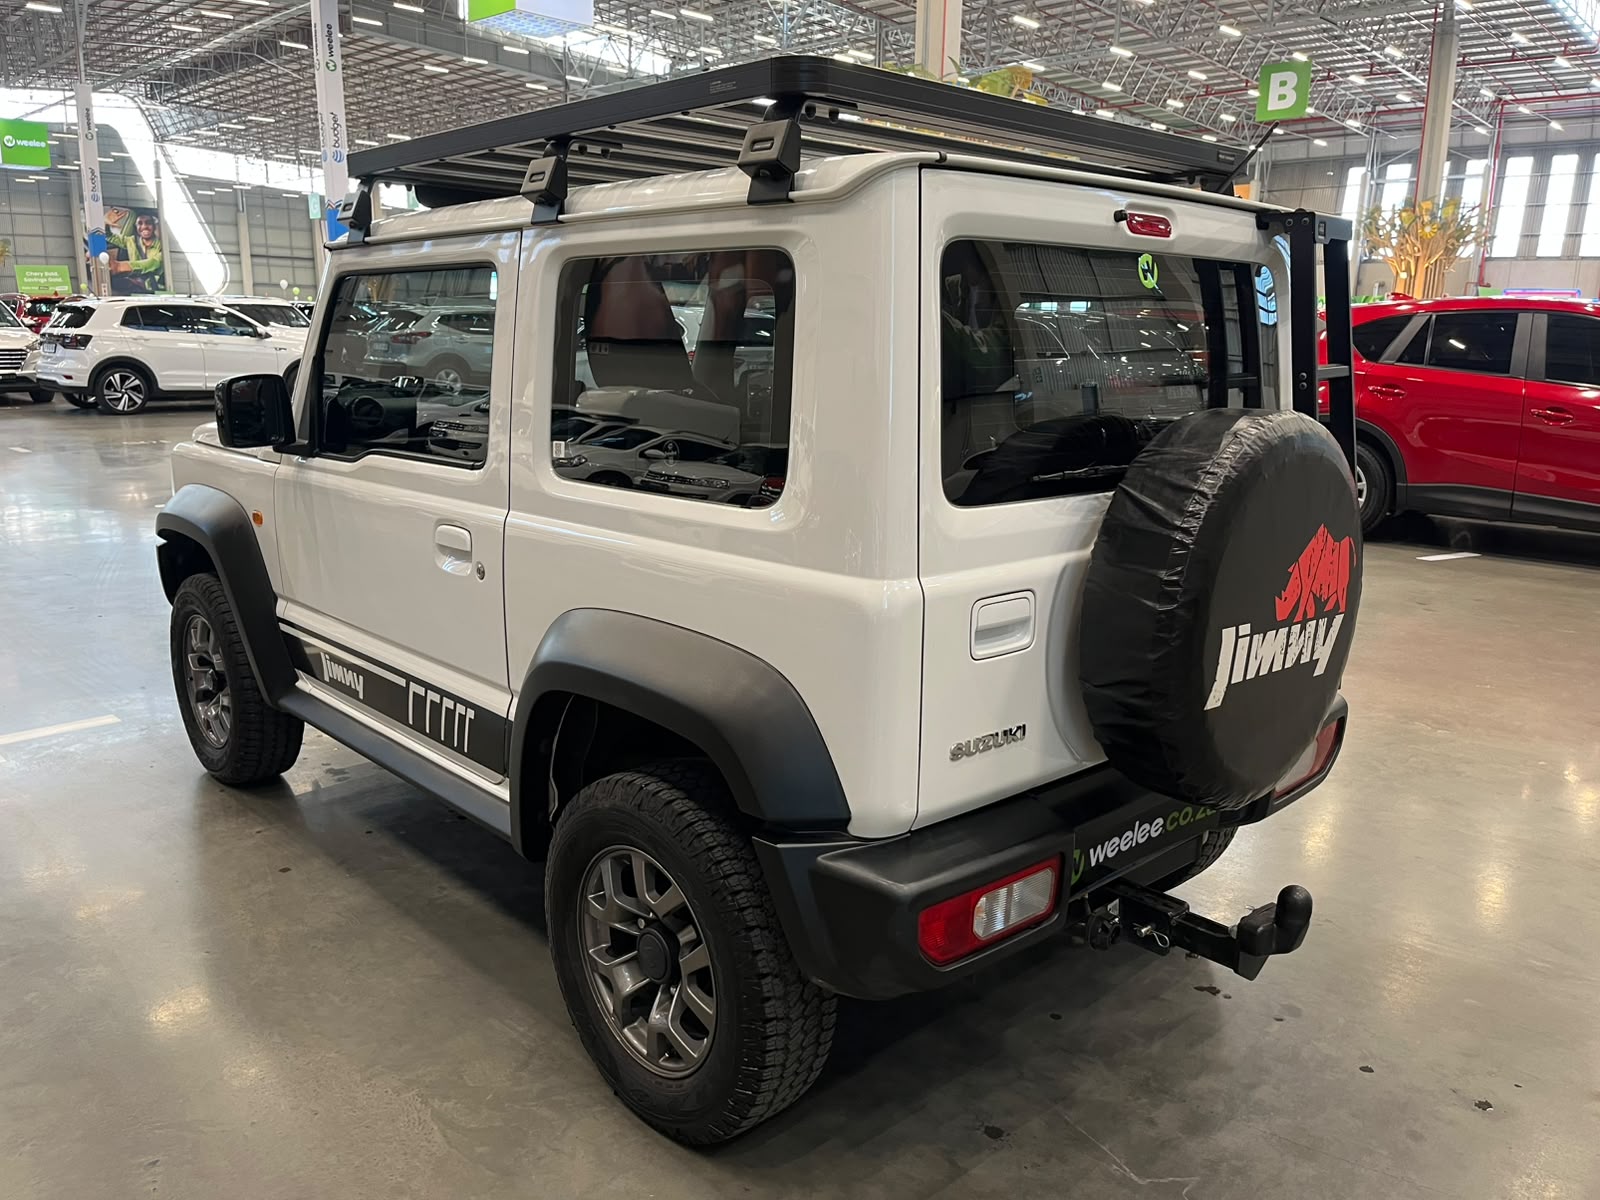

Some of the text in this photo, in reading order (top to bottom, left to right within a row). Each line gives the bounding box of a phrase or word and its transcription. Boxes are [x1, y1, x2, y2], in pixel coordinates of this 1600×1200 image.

[325, 23, 334, 57] weelee
[1267, 71, 1298, 111] B
[16, 139, 46, 148] weelee
[330, 112, 341, 148] budget
[949, 723, 1026, 762] SUZUKI
